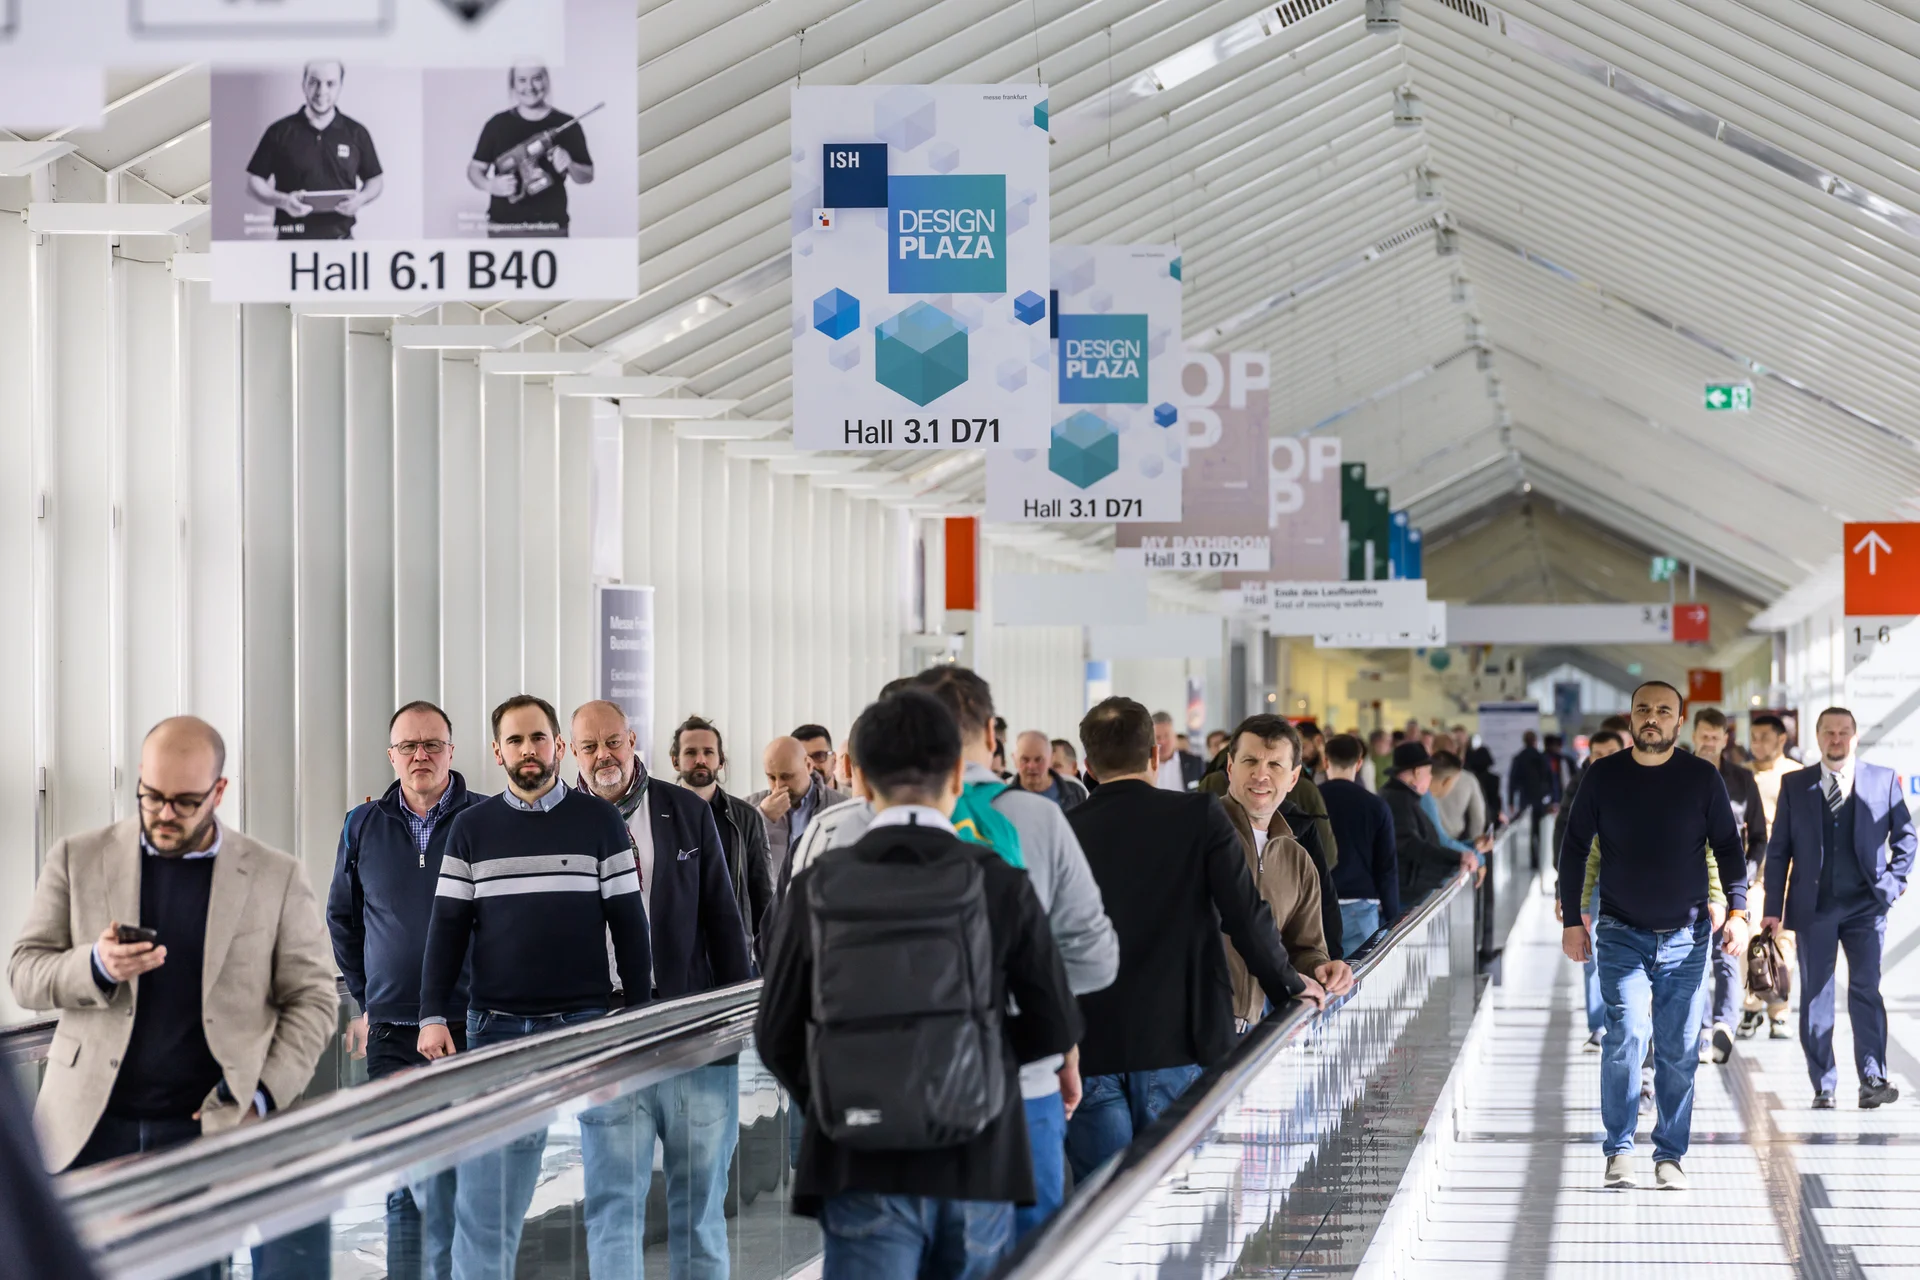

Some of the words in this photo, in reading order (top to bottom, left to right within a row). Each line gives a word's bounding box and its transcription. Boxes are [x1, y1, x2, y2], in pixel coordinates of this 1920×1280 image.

[830, 151, 860, 168] ISH
[899, 209, 995, 233] DESIGN
[899, 235, 995, 259] PLAZA
[291, 252, 368, 290] Hall
[390, 251, 446, 290] 6.1
[468, 250, 557, 289] B40
[1066, 340, 1140, 358] DESIGN
[1066, 360, 1140, 378] PLAZA
[1181, 351, 1270, 409] OP
[844, 419, 893, 444] Hall
[904, 419, 939, 443] 3.1
[951, 419, 1000, 443] D71
[1269, 437, 1342, 482] OP
[1024, 499, 1061, 517] Hall
[1069, 499, 1096, 517] 3.1
[1106, 499, 1143, 517] D71
[1141, 536, 1167, 549] MY
[1144, 551, 1175, 567] Hall
[1181, 551, 1202, 567] 3.1
[1209, 551, 1239, 567] D71
[1275, 588, 1298, 597] Ende
[1275, 600, 1293, 609] End
